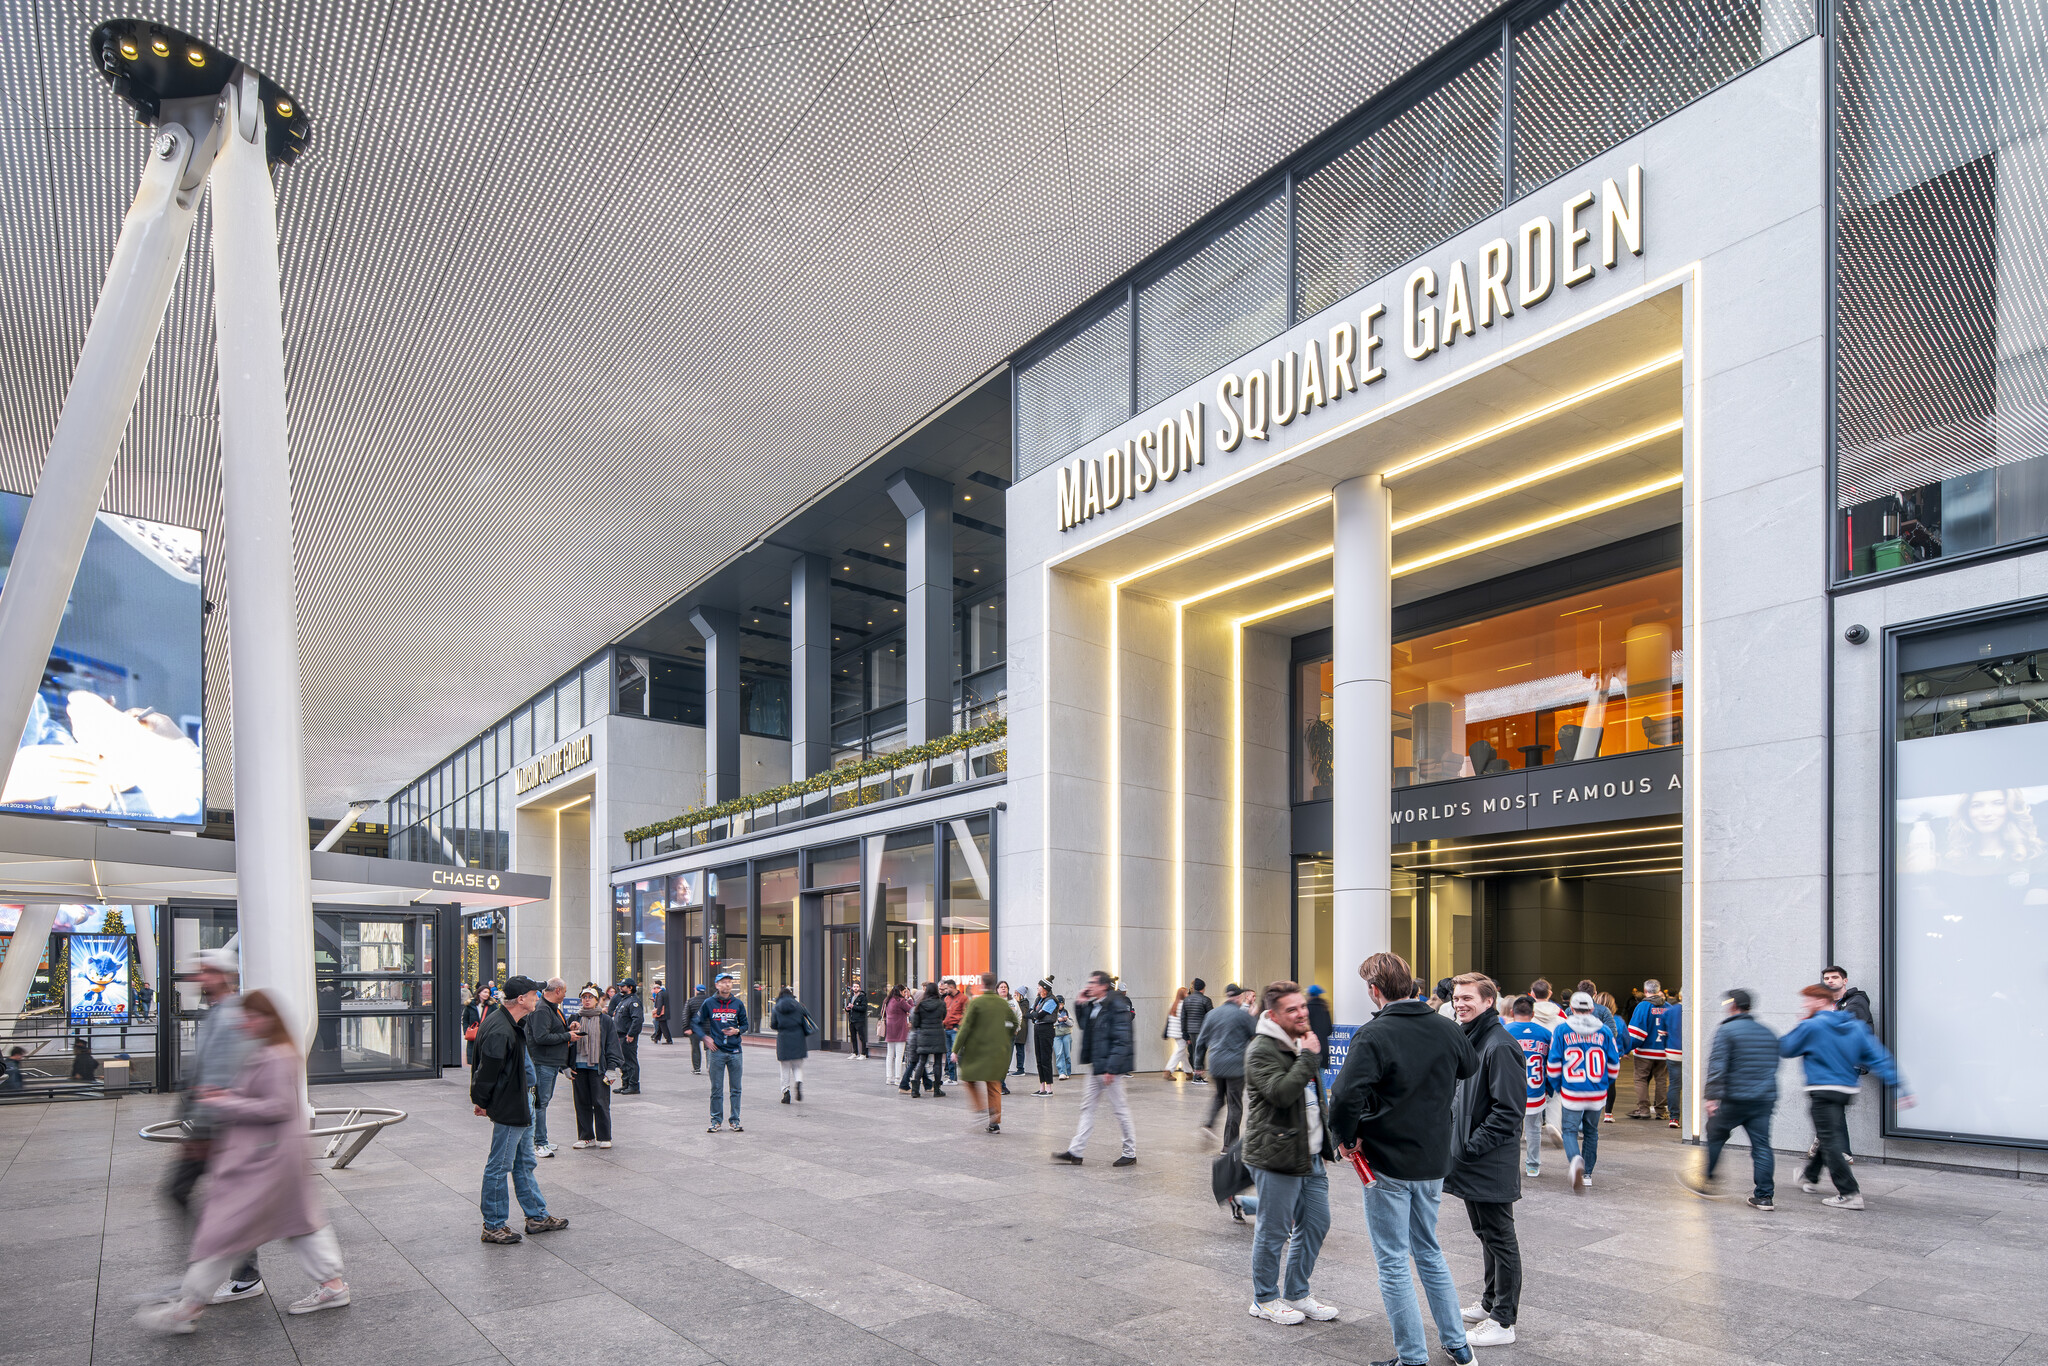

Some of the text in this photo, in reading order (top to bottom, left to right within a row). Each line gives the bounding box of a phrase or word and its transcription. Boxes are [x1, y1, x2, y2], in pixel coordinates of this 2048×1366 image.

[1057, 164, 1644, 532] MADISON SQUARE GARDEN
[515, 734, 592, 795] MADISON SQUARE GARDEN
[1391, 801, 1472, 825] WORLD'S
[1483, 792, 1541, 814] MOST
[1552, 777, 1653, 805] FAMOUS
[432, 870, 485, 888] CHASE
[472, 915, 488, 930] CHASE
[1562, 1047, 1607, 1084] 20
